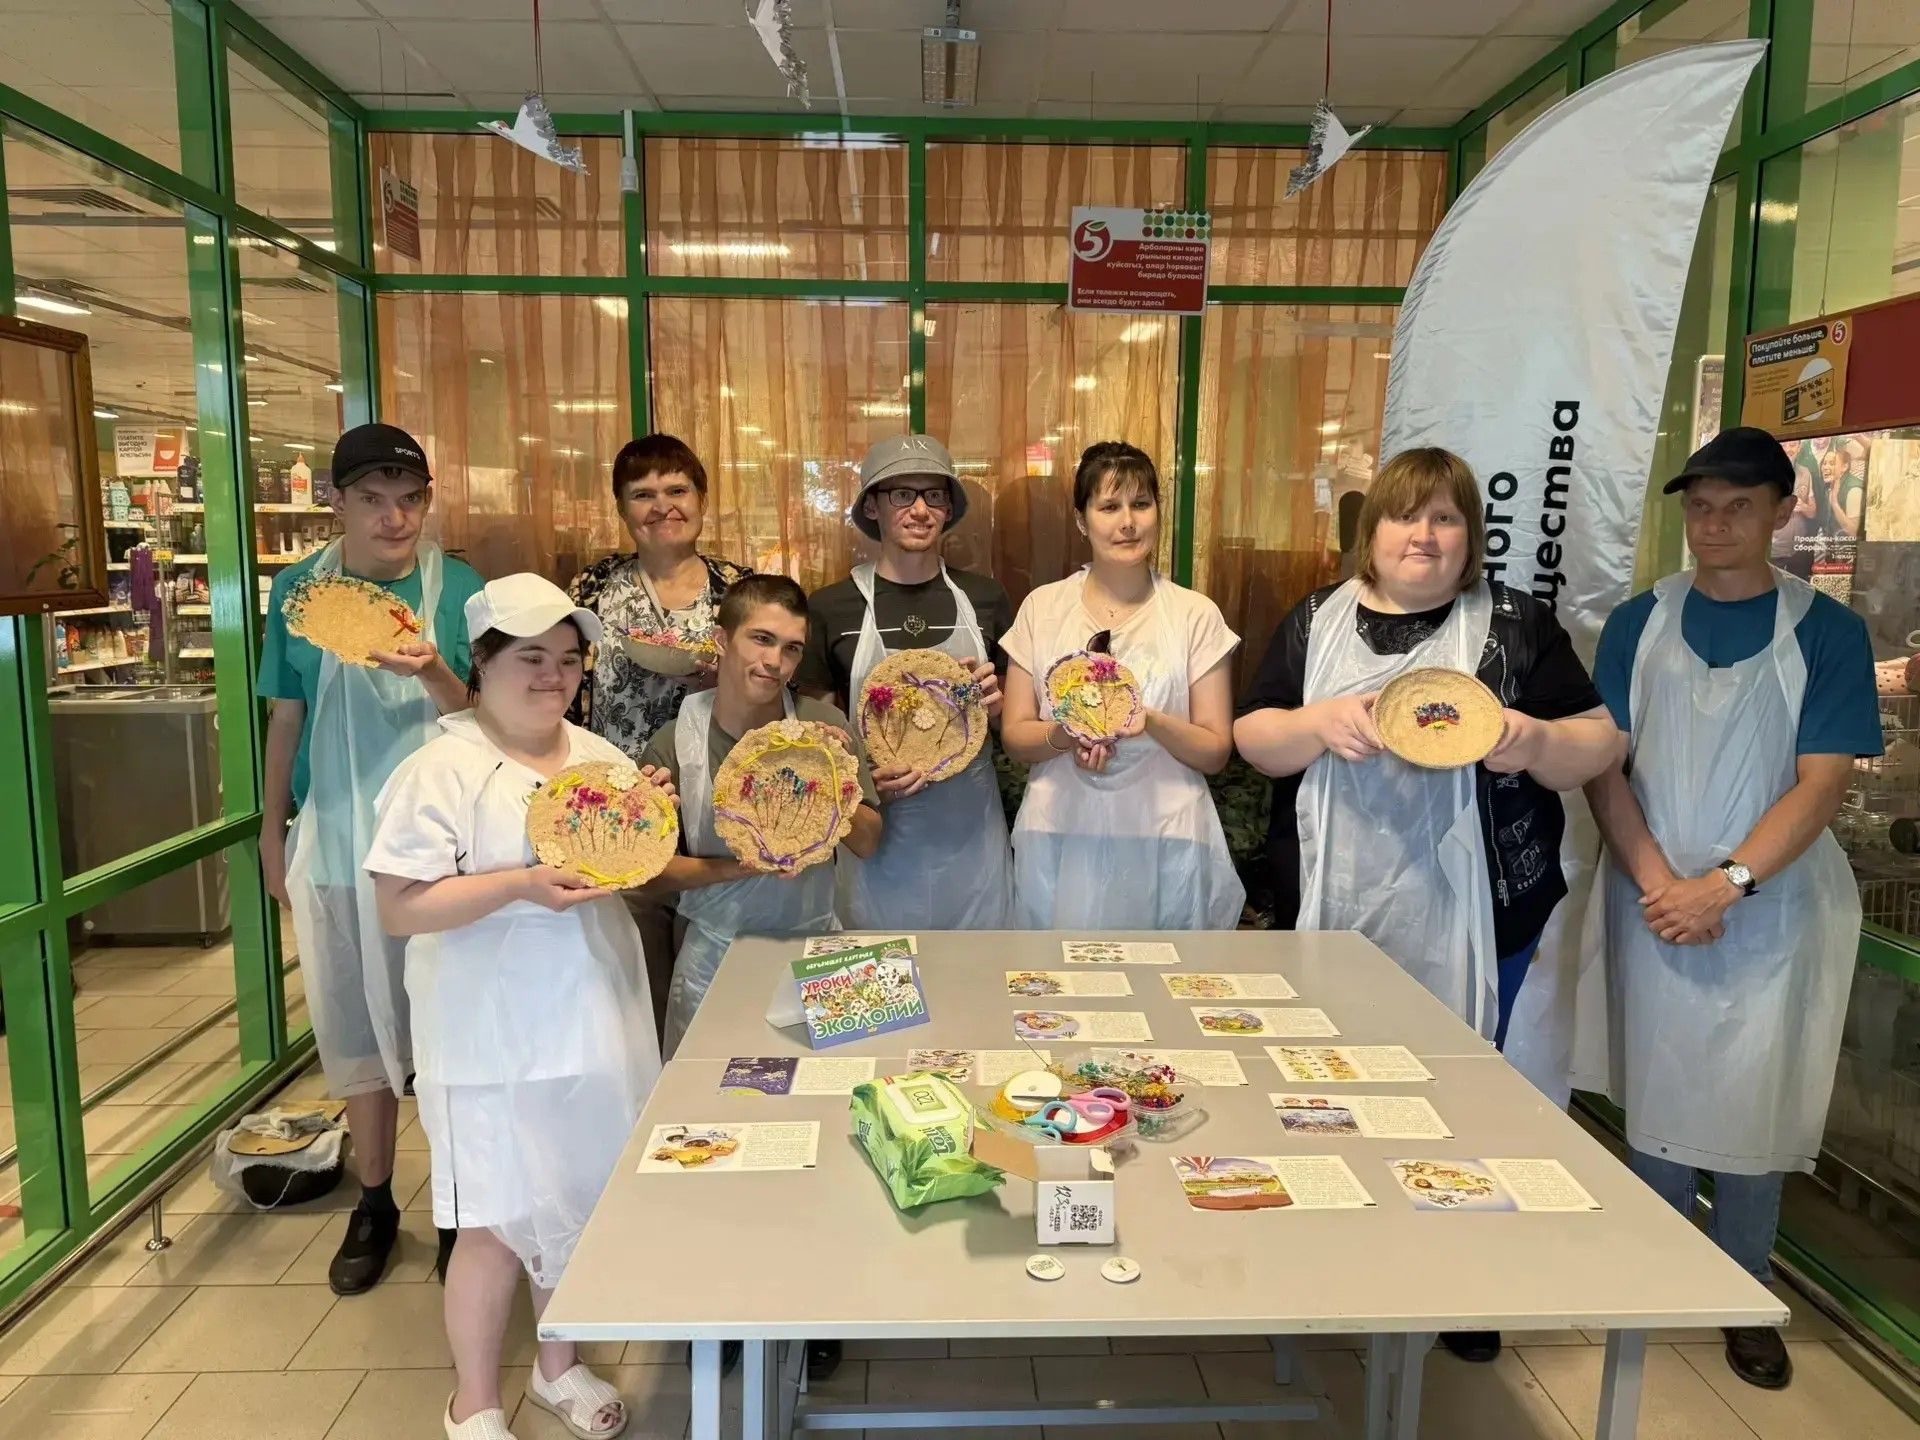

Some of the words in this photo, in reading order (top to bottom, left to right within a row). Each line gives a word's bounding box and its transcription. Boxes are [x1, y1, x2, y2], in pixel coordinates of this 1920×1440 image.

[1077, 287, 1095, 296] Если
[1751, 336, 1792, 354] Покупайте
[1752, 352, 1783, 365] платите
[1783, 343, 1817, 359] меньше!
[802, 975, 854, 995] УРОКИ
[813, 999, 925, 1039] ЭКОЛОГИИ
